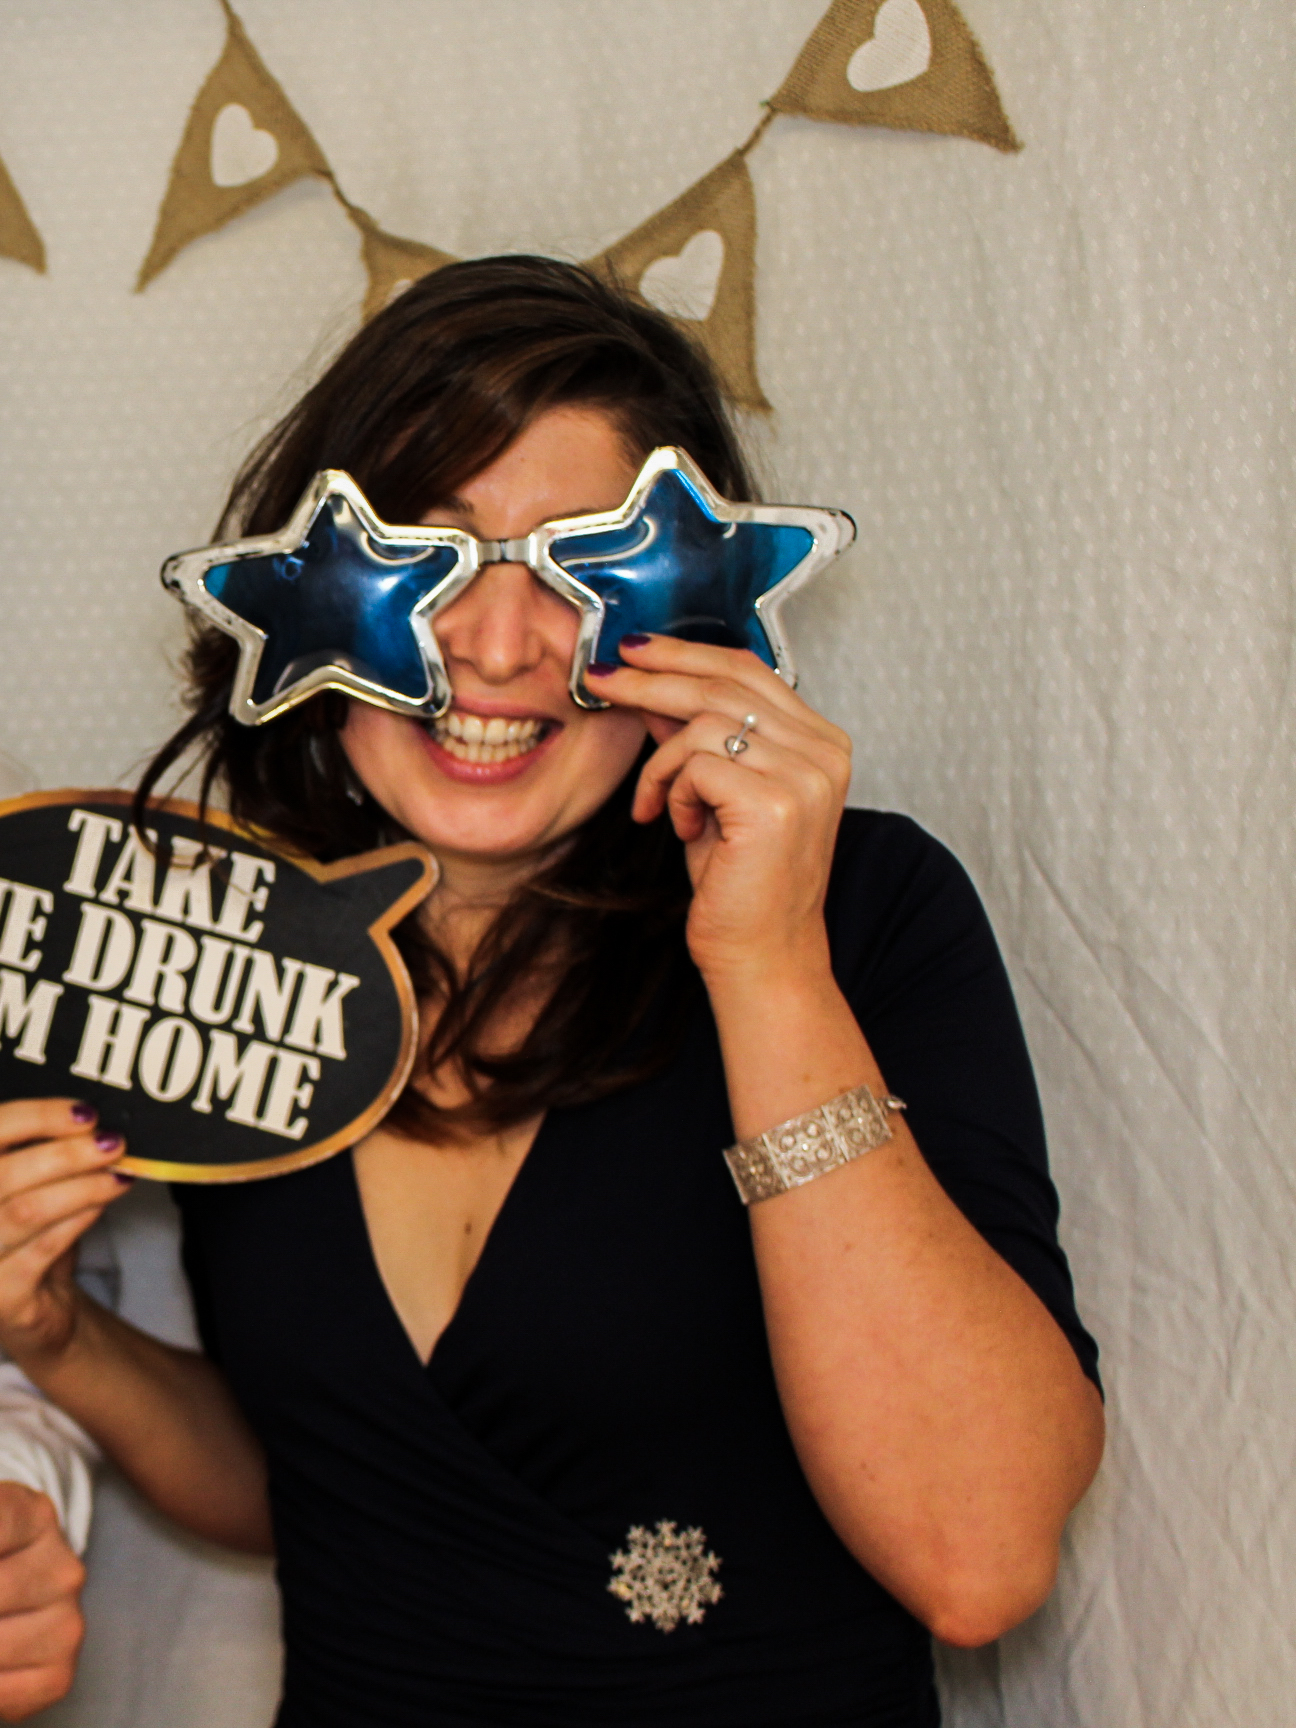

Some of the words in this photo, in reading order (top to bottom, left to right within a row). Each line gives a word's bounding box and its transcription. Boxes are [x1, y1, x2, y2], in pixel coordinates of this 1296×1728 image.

[64, 809, 276, 942] TAKE
[63, 902, 360, 1060] DRUNK
[70, 993, 320, 1140] HOME
